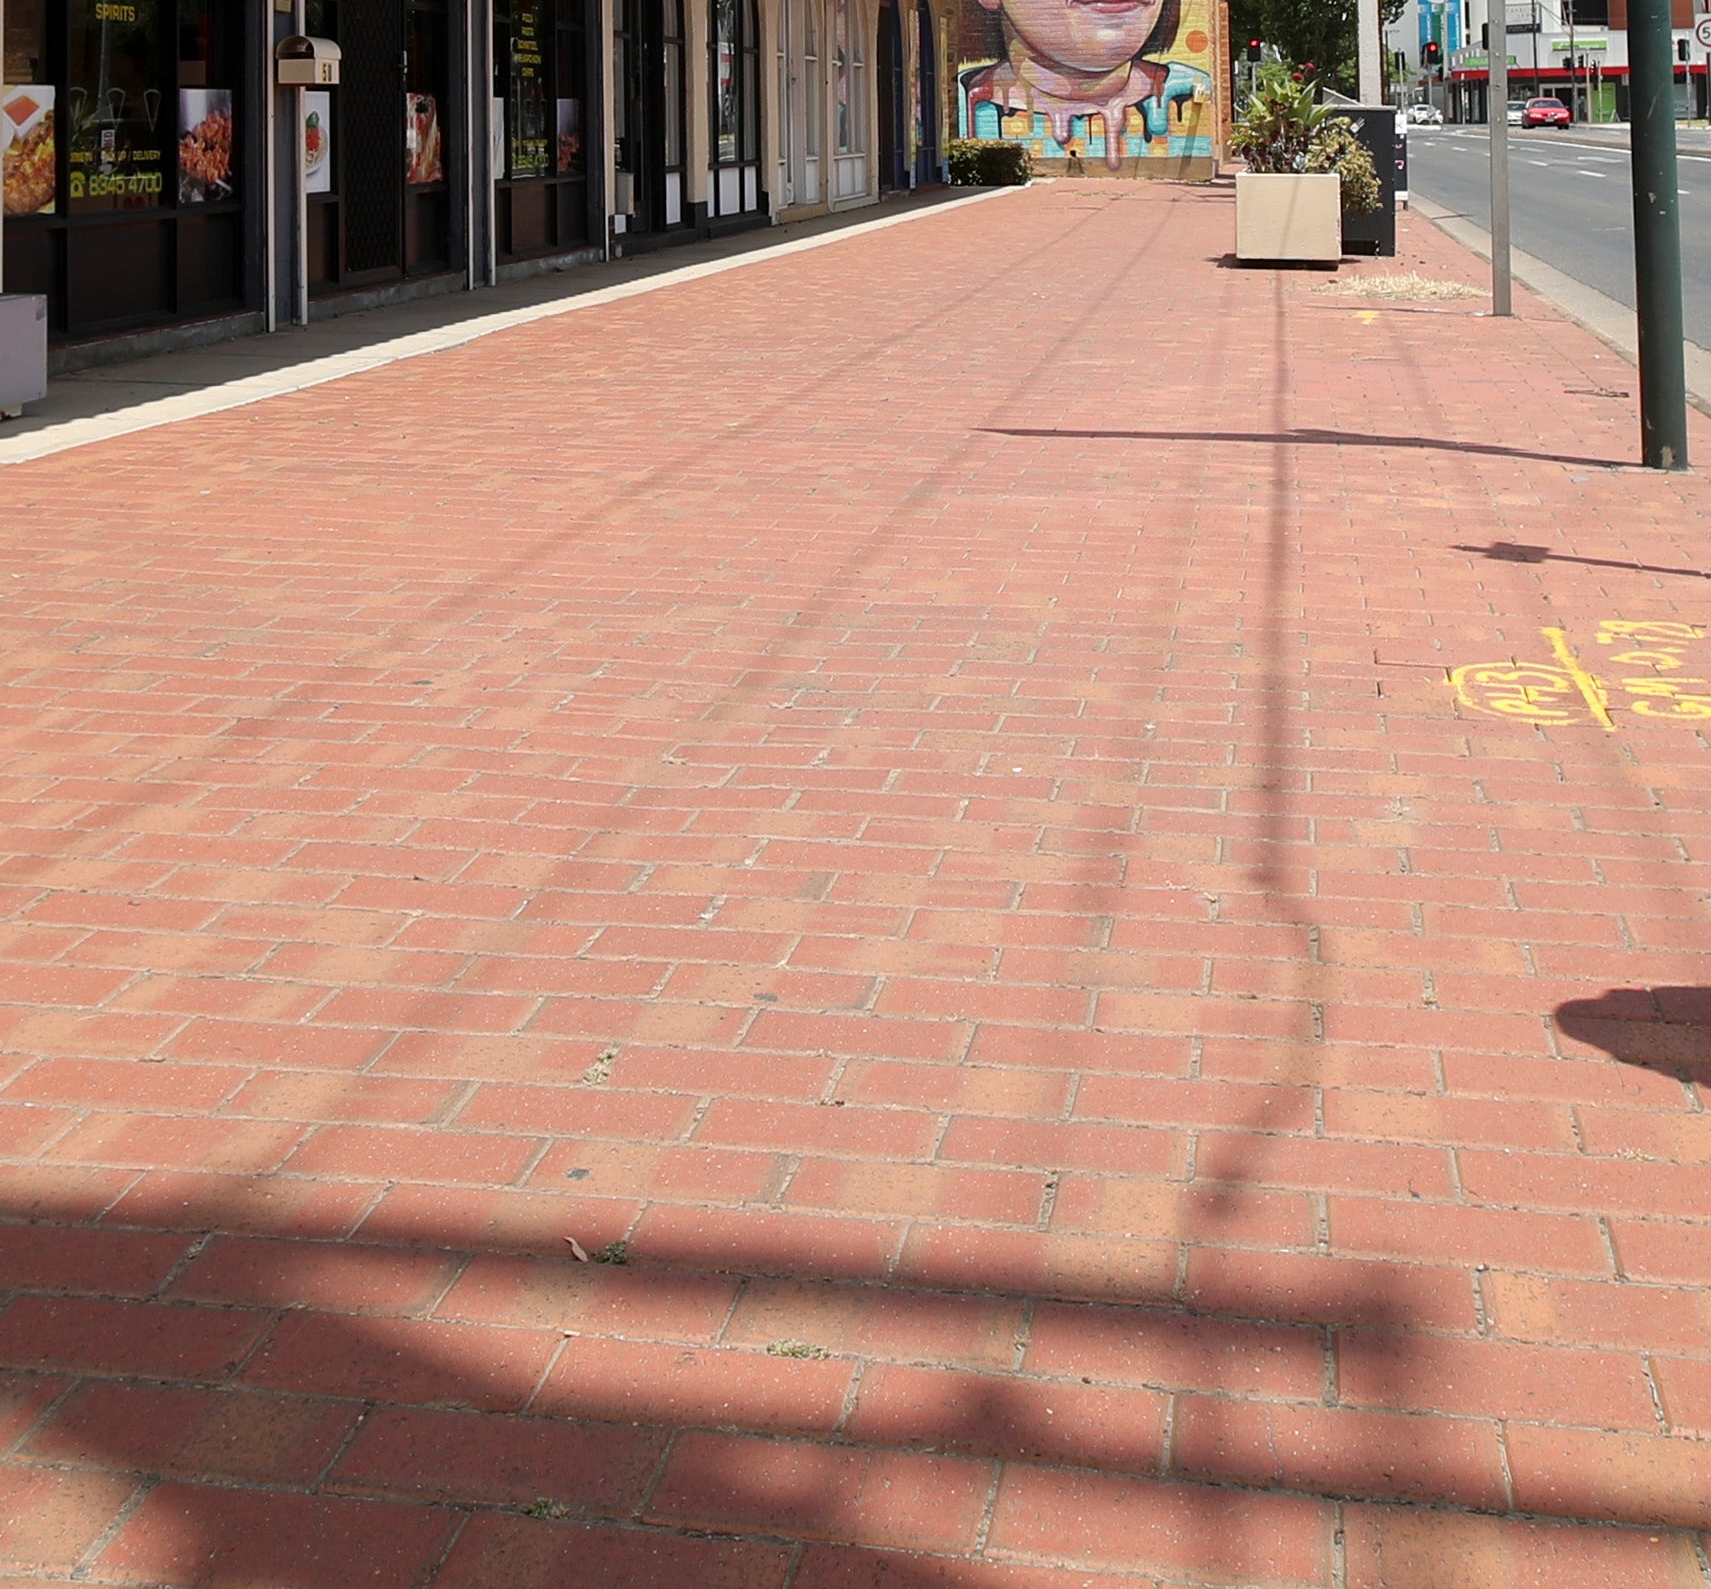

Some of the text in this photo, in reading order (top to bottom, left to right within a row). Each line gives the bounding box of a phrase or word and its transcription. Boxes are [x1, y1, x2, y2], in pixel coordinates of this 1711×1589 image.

[95, 3, 136, 23] SPIRITS
[133, 149, 162, 161] DELIVERY
[89, 171, 163, 196] 8345 4700
